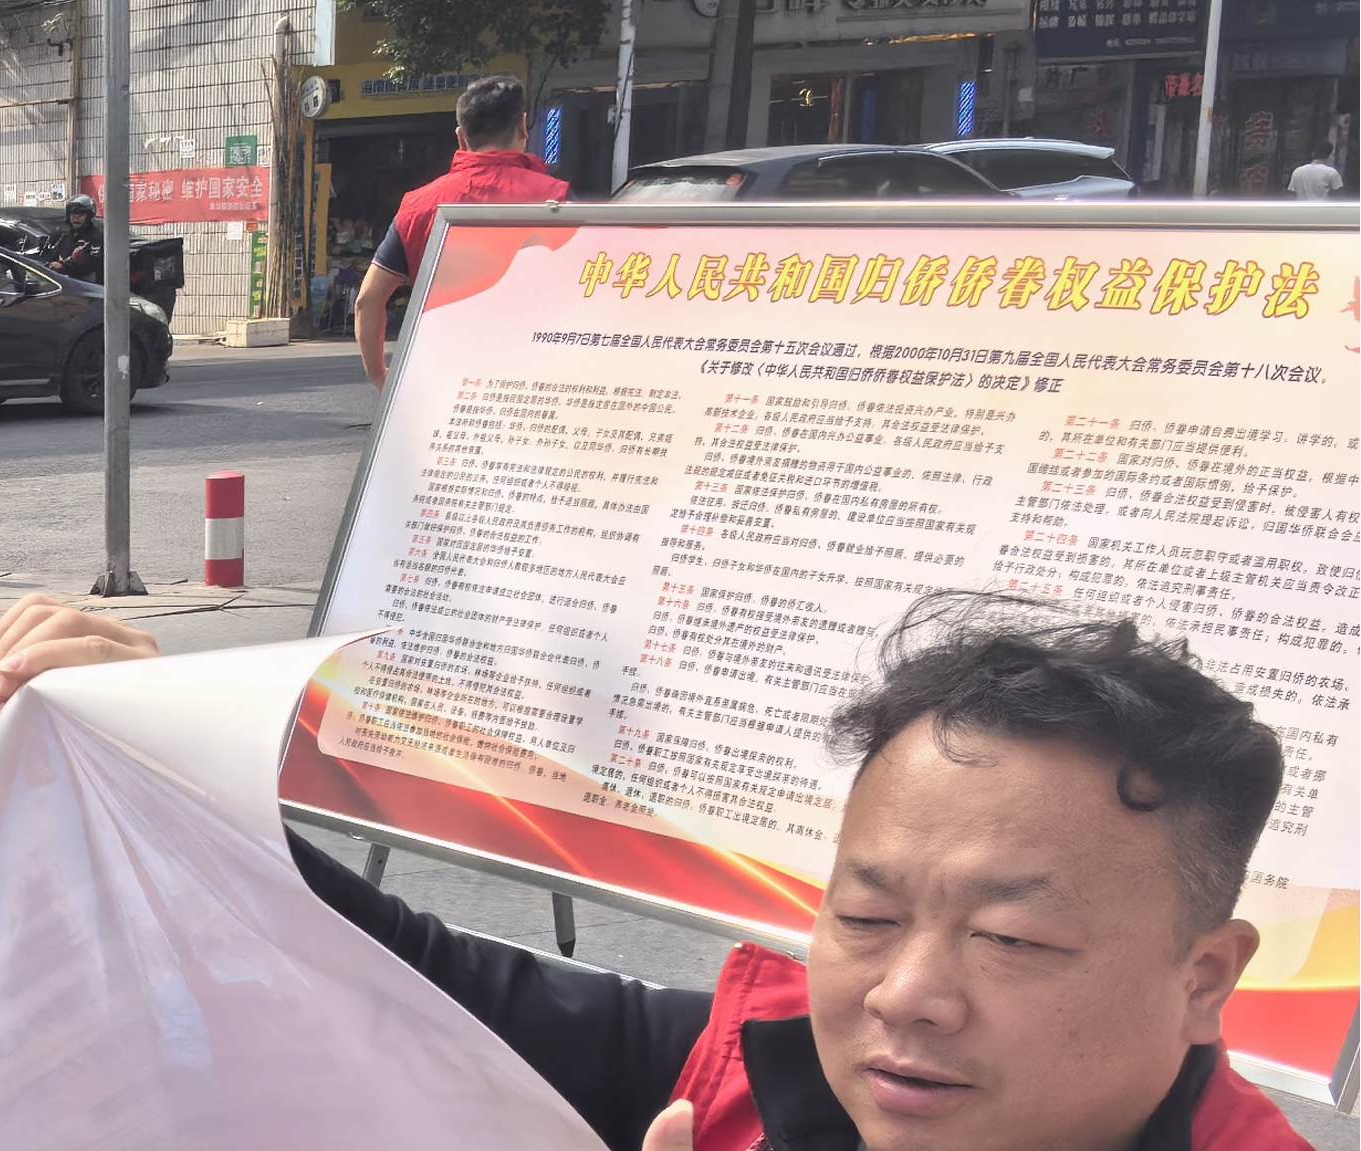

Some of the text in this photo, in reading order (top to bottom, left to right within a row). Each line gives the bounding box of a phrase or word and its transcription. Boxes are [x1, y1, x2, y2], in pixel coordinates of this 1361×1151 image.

[181, 175, 263, 200] 维护国家安全
[578, 252, 1320, 320] 中华人民共和国归侨侨眷权益保护法
